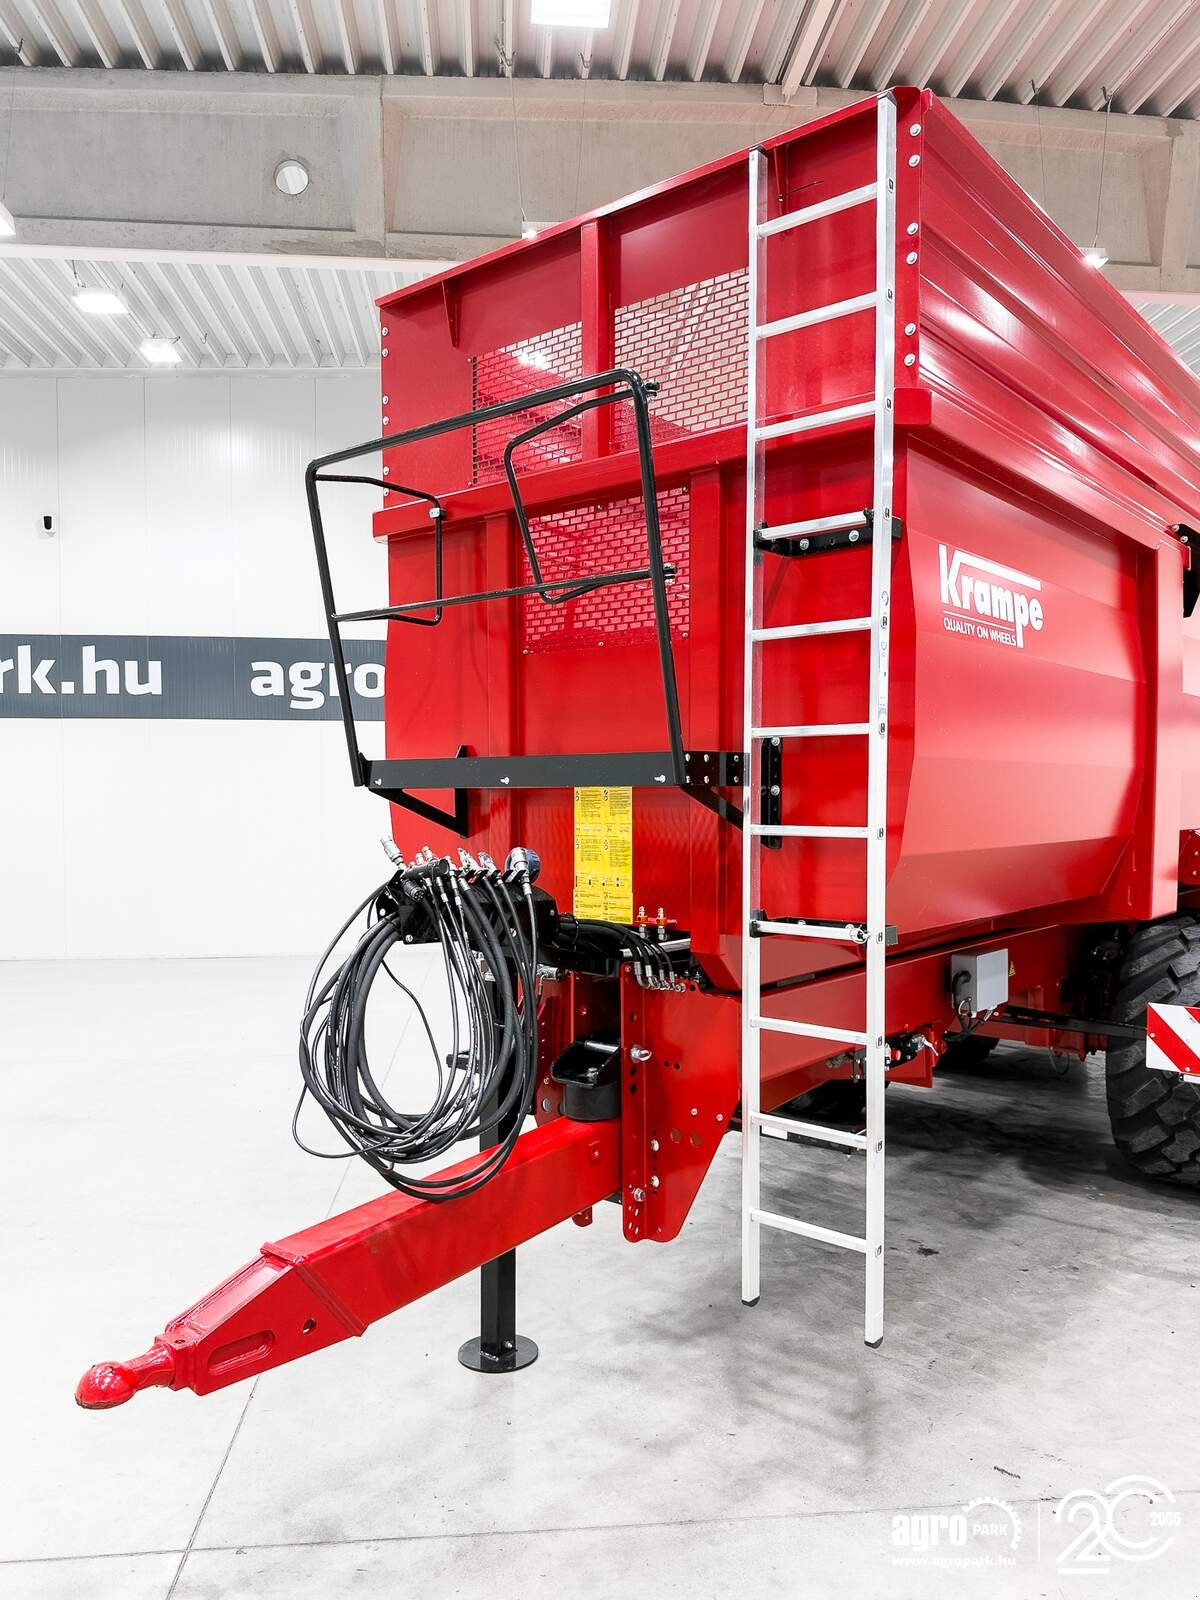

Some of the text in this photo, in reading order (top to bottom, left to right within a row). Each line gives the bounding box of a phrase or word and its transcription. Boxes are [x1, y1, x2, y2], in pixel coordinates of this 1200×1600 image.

[938, 543, 1044, 648] Krampe
[943, 617, 1017, 646] QUALITY ON WHEELS
[250, 661, 385, 710] agro
